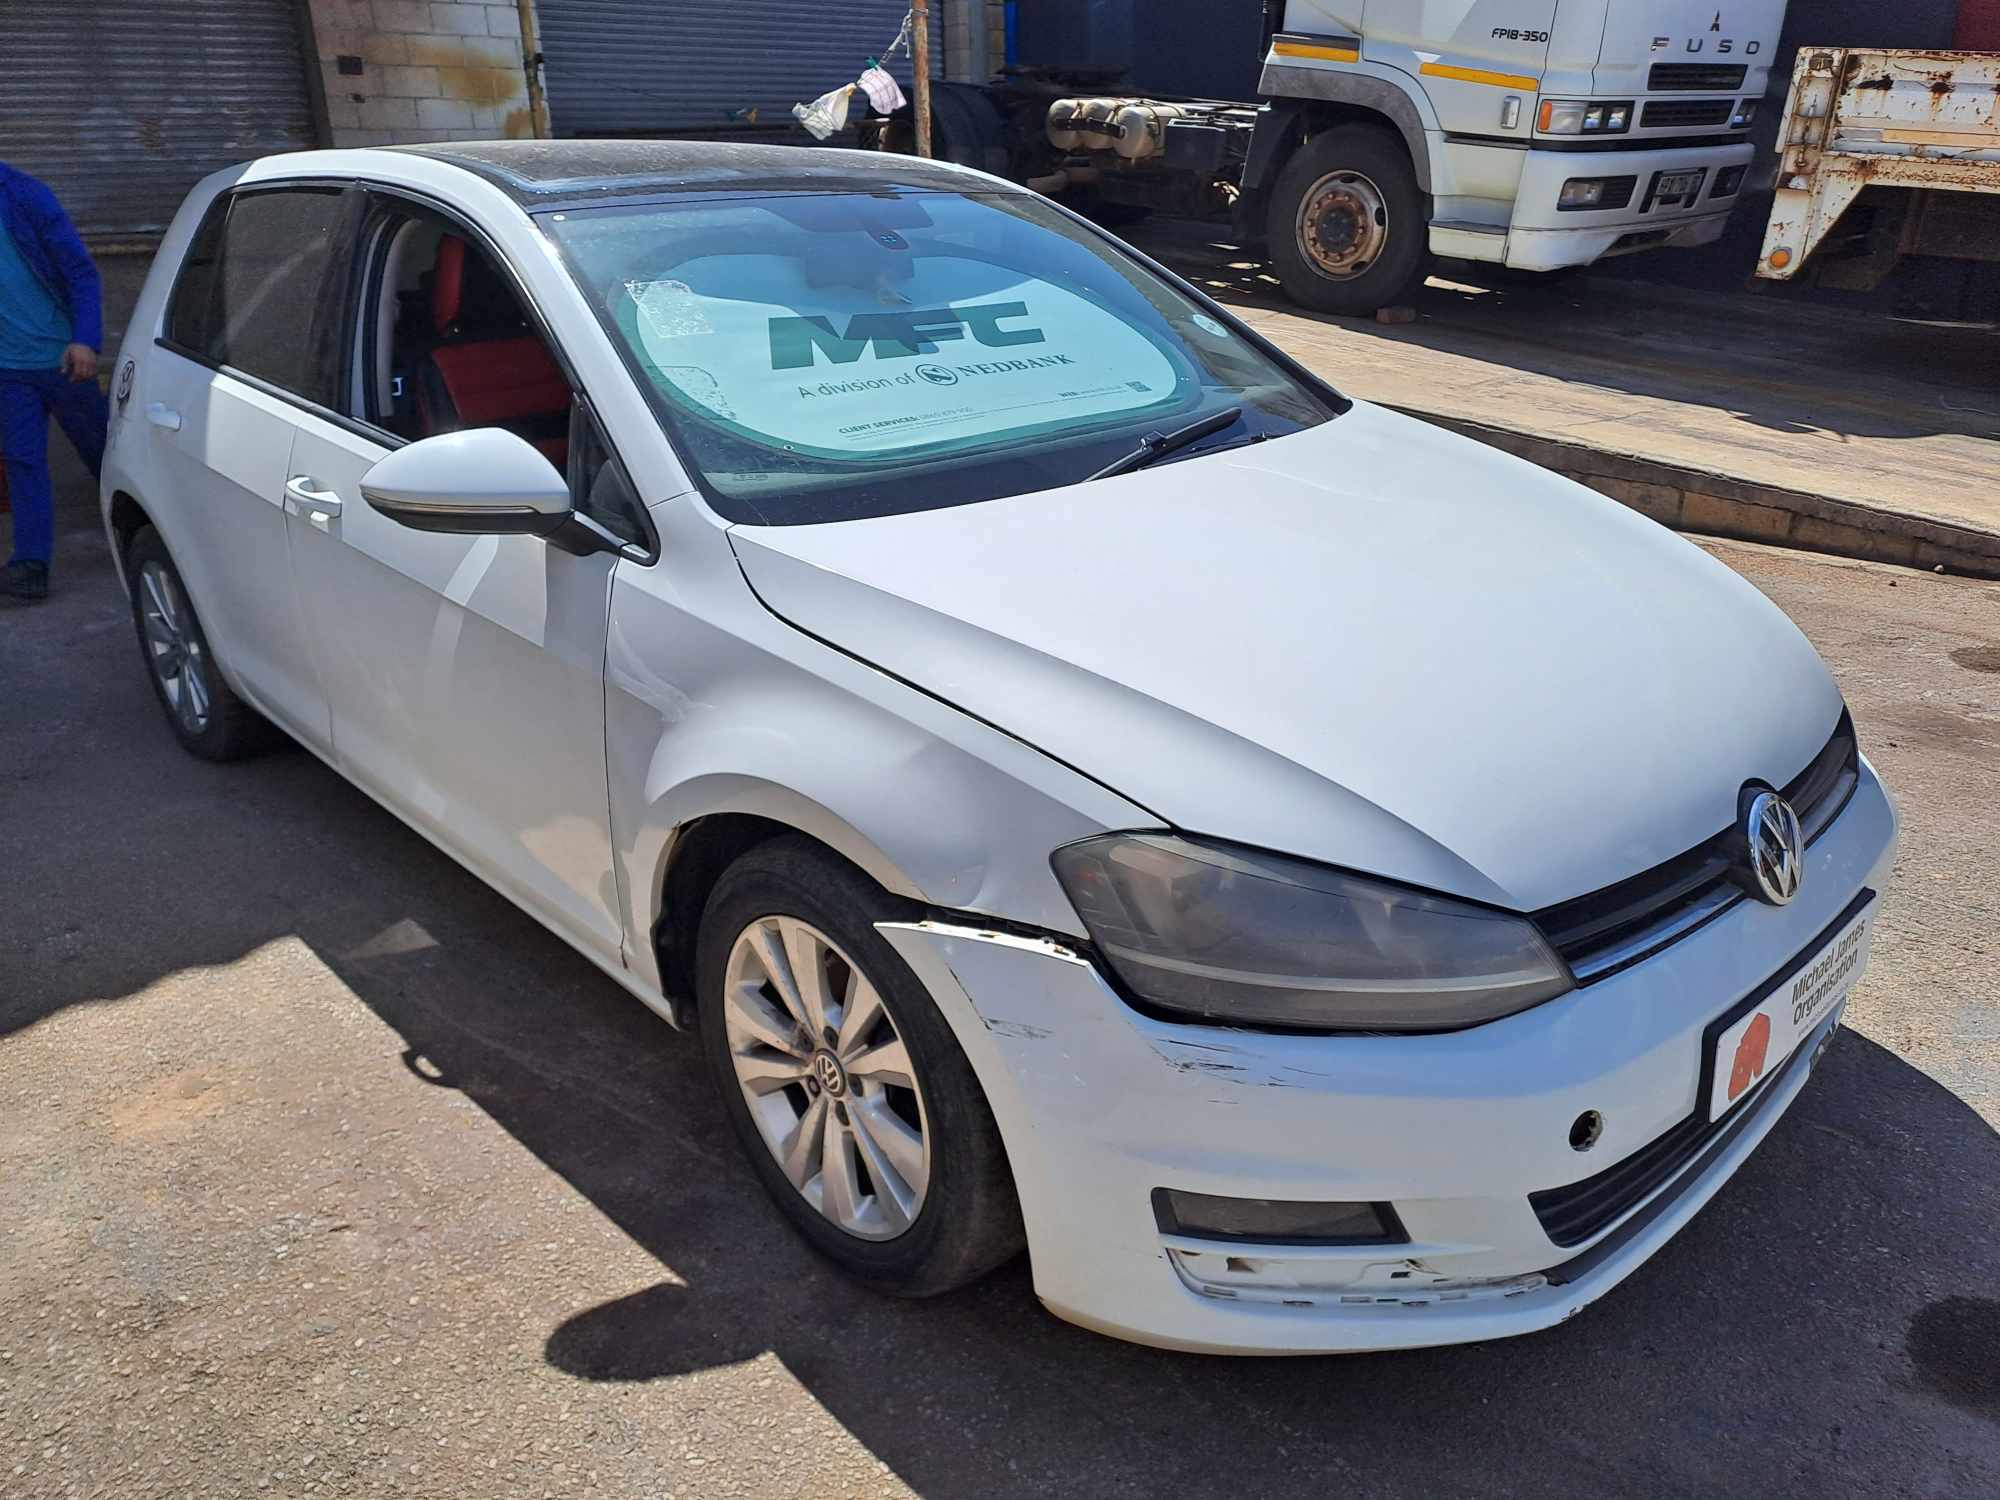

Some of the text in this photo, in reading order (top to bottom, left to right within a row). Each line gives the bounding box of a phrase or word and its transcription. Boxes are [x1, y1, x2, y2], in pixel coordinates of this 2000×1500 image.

[1651, 36, 1761, 56] FUSO
[767, 301, 1046, 370] MFC
[798, 353, 1076, 400] A division of NEDBANK
[838, 423, 872, 435] CLIENT
[1791, 919, 1866, 1006] Michael James
[1793, 947, 1859, 1026] Organisation
